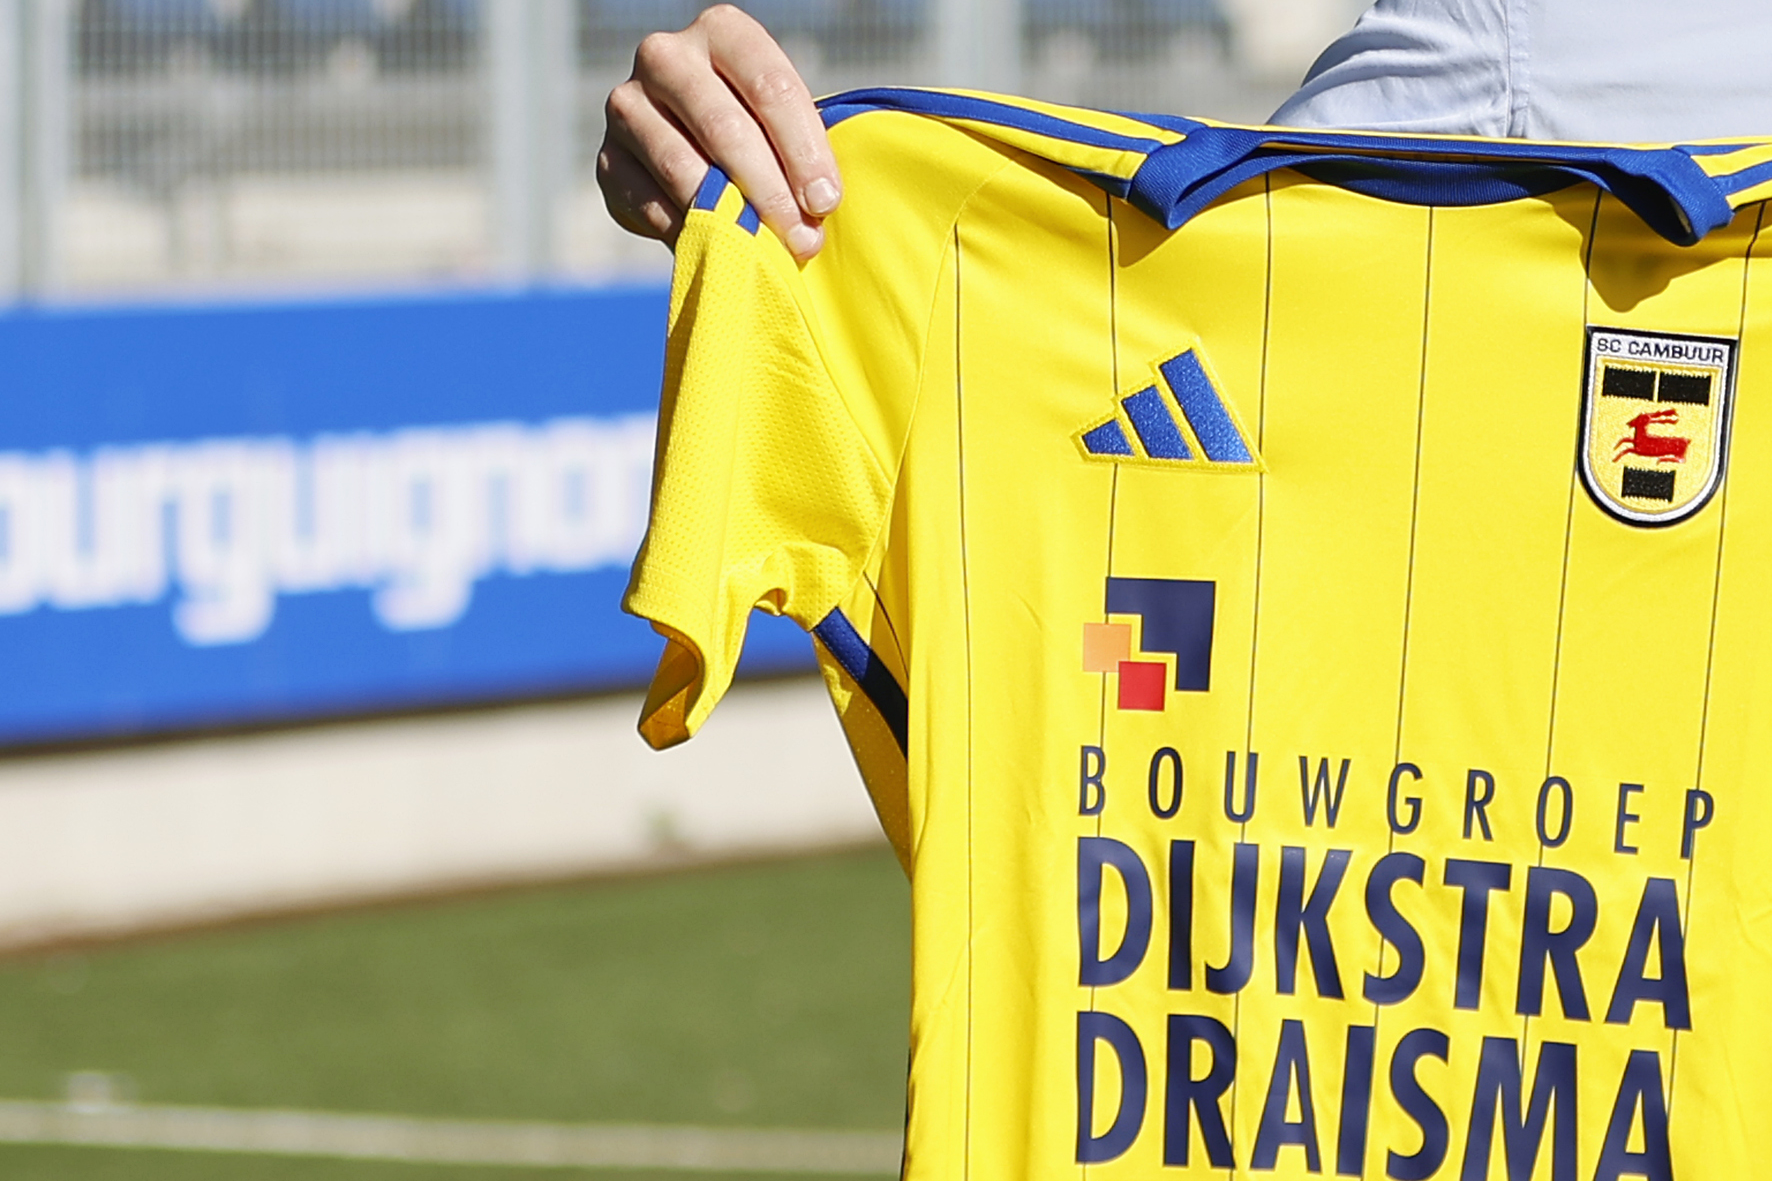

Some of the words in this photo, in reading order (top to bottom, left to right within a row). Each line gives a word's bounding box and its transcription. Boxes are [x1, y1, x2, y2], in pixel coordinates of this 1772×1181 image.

[1597, 338, 1622, 353] SC
[1628, 340, 1724, 363] CAMBUUR
[1077, 745, 1715, 860] BOUWGROEP
[1076, 835, 1693, 1031] DIJKSTRA
[1074, 1009, 1675, 1181] DRAISMA
